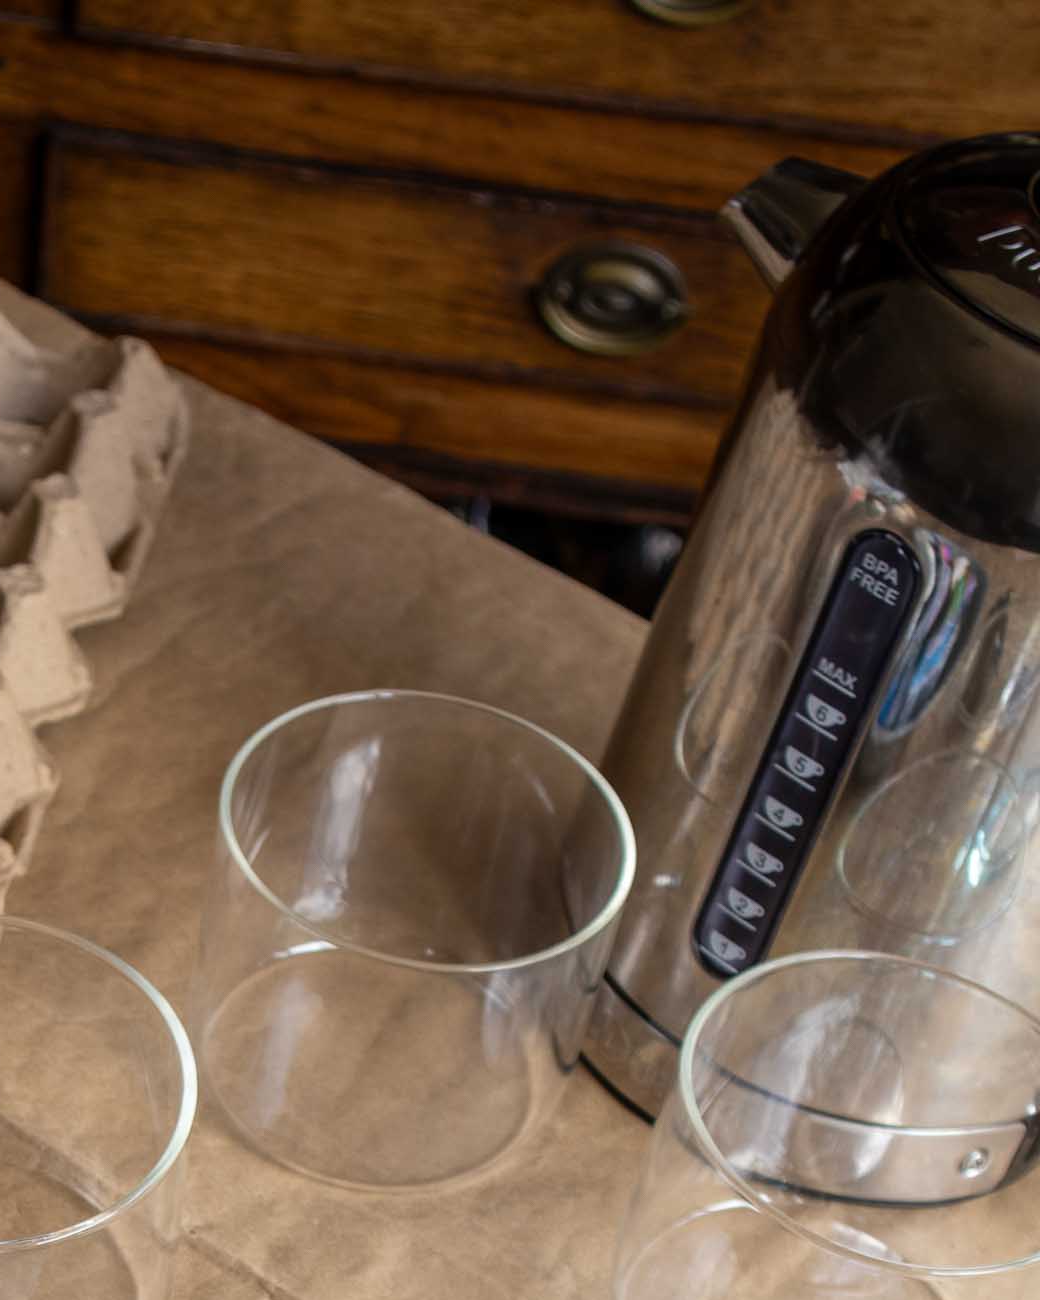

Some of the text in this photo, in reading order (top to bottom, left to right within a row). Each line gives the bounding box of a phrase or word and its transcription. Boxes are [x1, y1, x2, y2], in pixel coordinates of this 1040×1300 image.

[861, 553, 899, 586] BPA
[849, 569, 899, 606] FREE
[818, 658, 857, 689] MAX
[815, 705, 829, 723] 6
[794, 756, 807, 774] 5
[772, 806, 785, 824] 4
[755, 853, 767, 870] 3
[736, 898, 748, 915] 2
